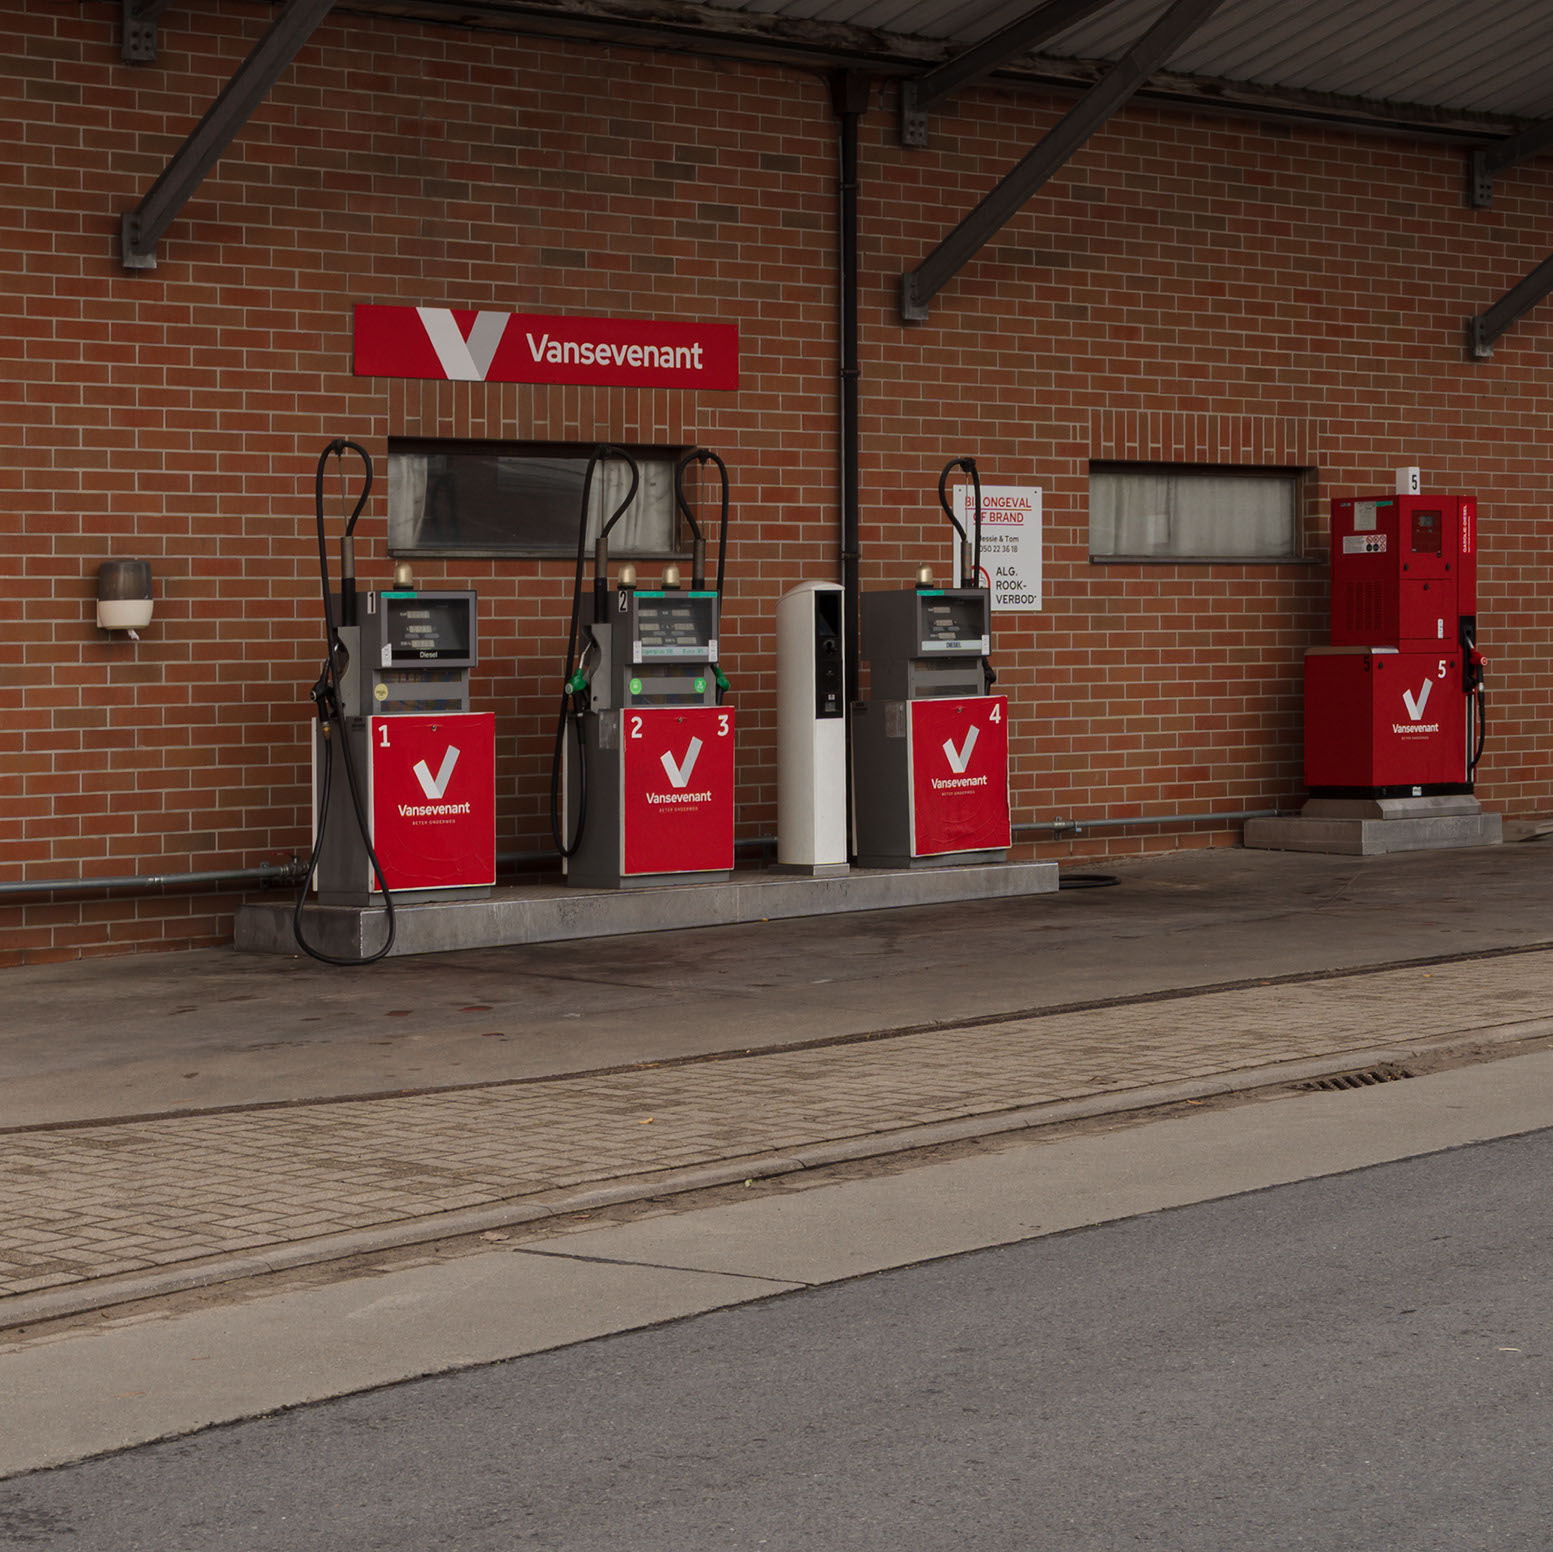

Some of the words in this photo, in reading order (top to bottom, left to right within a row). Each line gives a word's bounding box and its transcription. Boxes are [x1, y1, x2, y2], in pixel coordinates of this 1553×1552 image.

[525, 332, 703, 370] Vansevenant
[1411, 474, 1418, 490] 5
[982, 496, 1032, 508] ONGEVAL
[989, 512, 1024, 523] BRAND
[1005, 535, 1019, 543] Tom
[993, 545, 1000, 553] 22
[1002, 545, 1010, 553] 36
[1011, 545, 1018, 553] 18
[996, 566, 1018, 577] ALG.
[996, 580, 1027, 591] ROOK-
[369, 592, 374, 613] 1
[620, 591, 627, 612] 2
[419, 651, 439, 659] Diesel
[1437, 659, 1447, 679] 5
[989, 703, 1001, 724] 4
[630, 715, 643, 739] 2
[717, 714, 729, 737] 3
[1392, 722, 1439, 734] Vansevenant
[377, 724, 391, 748] 1
[931, 775, 988, 790] Vansevenant
[646, 791, 712, 805] Vansevenant
[397, 801, 471, 817] Vansevenant
